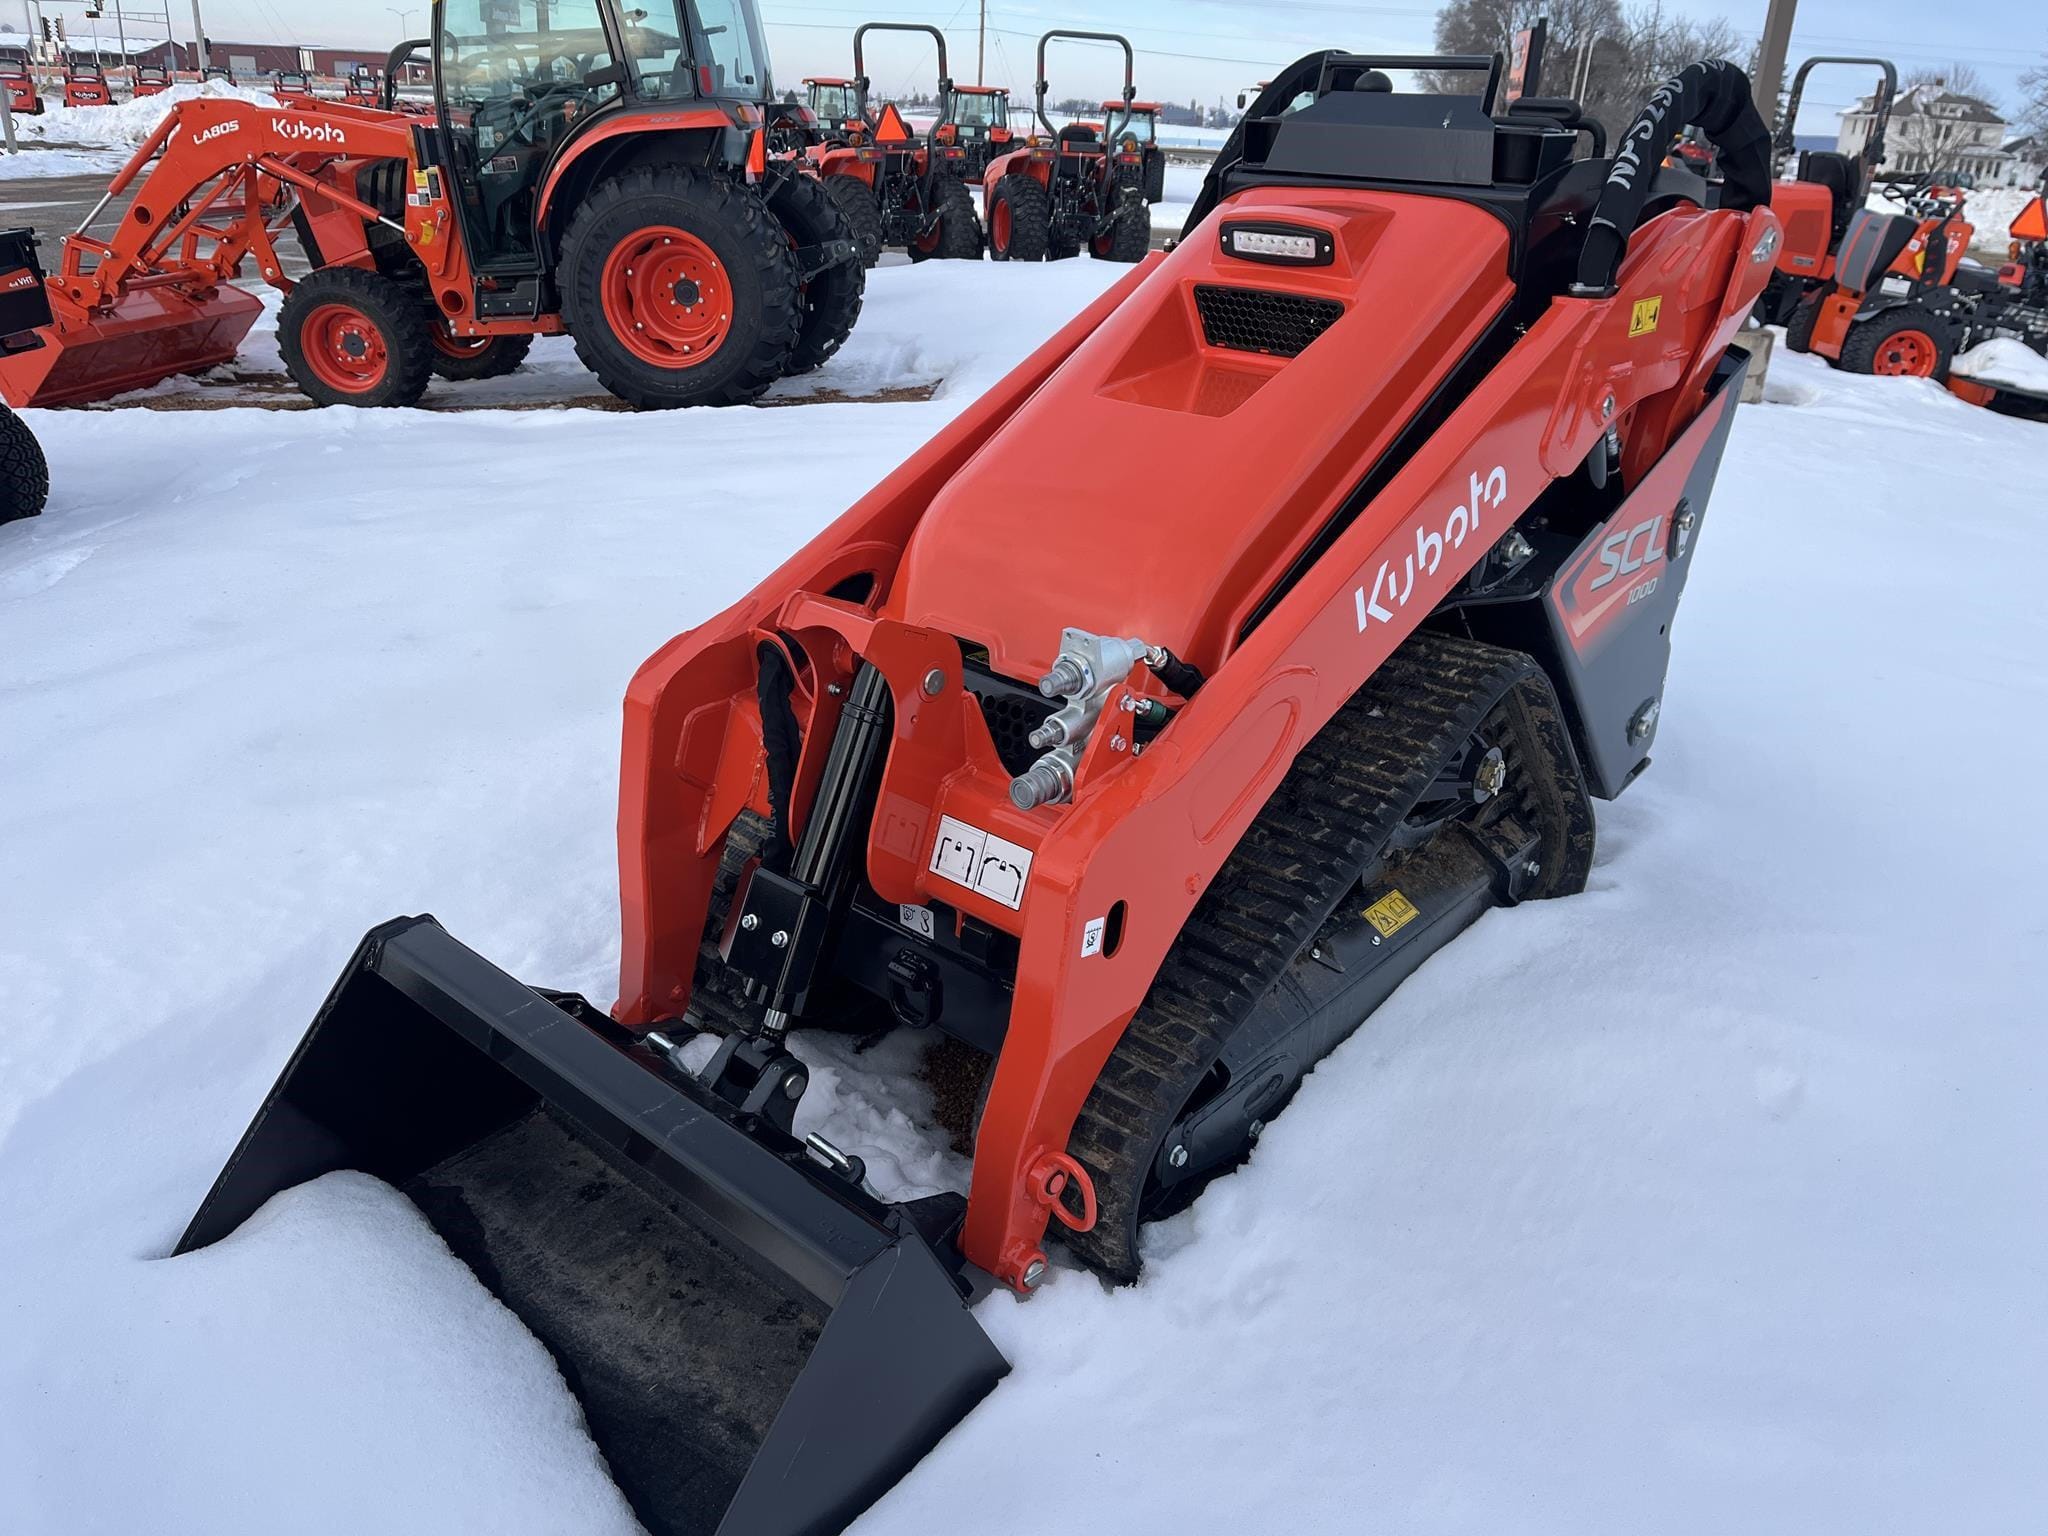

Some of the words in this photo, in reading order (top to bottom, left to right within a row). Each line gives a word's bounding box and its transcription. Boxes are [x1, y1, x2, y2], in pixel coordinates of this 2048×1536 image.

[193, 120, 240, 145] LA805
[272, 117, 345, 143] Kubota
[1355, 465, 1506, 633] Kubota
[1590, 514, 1664, 592] SCL
[1626, 577, 1658, 606] 1000
